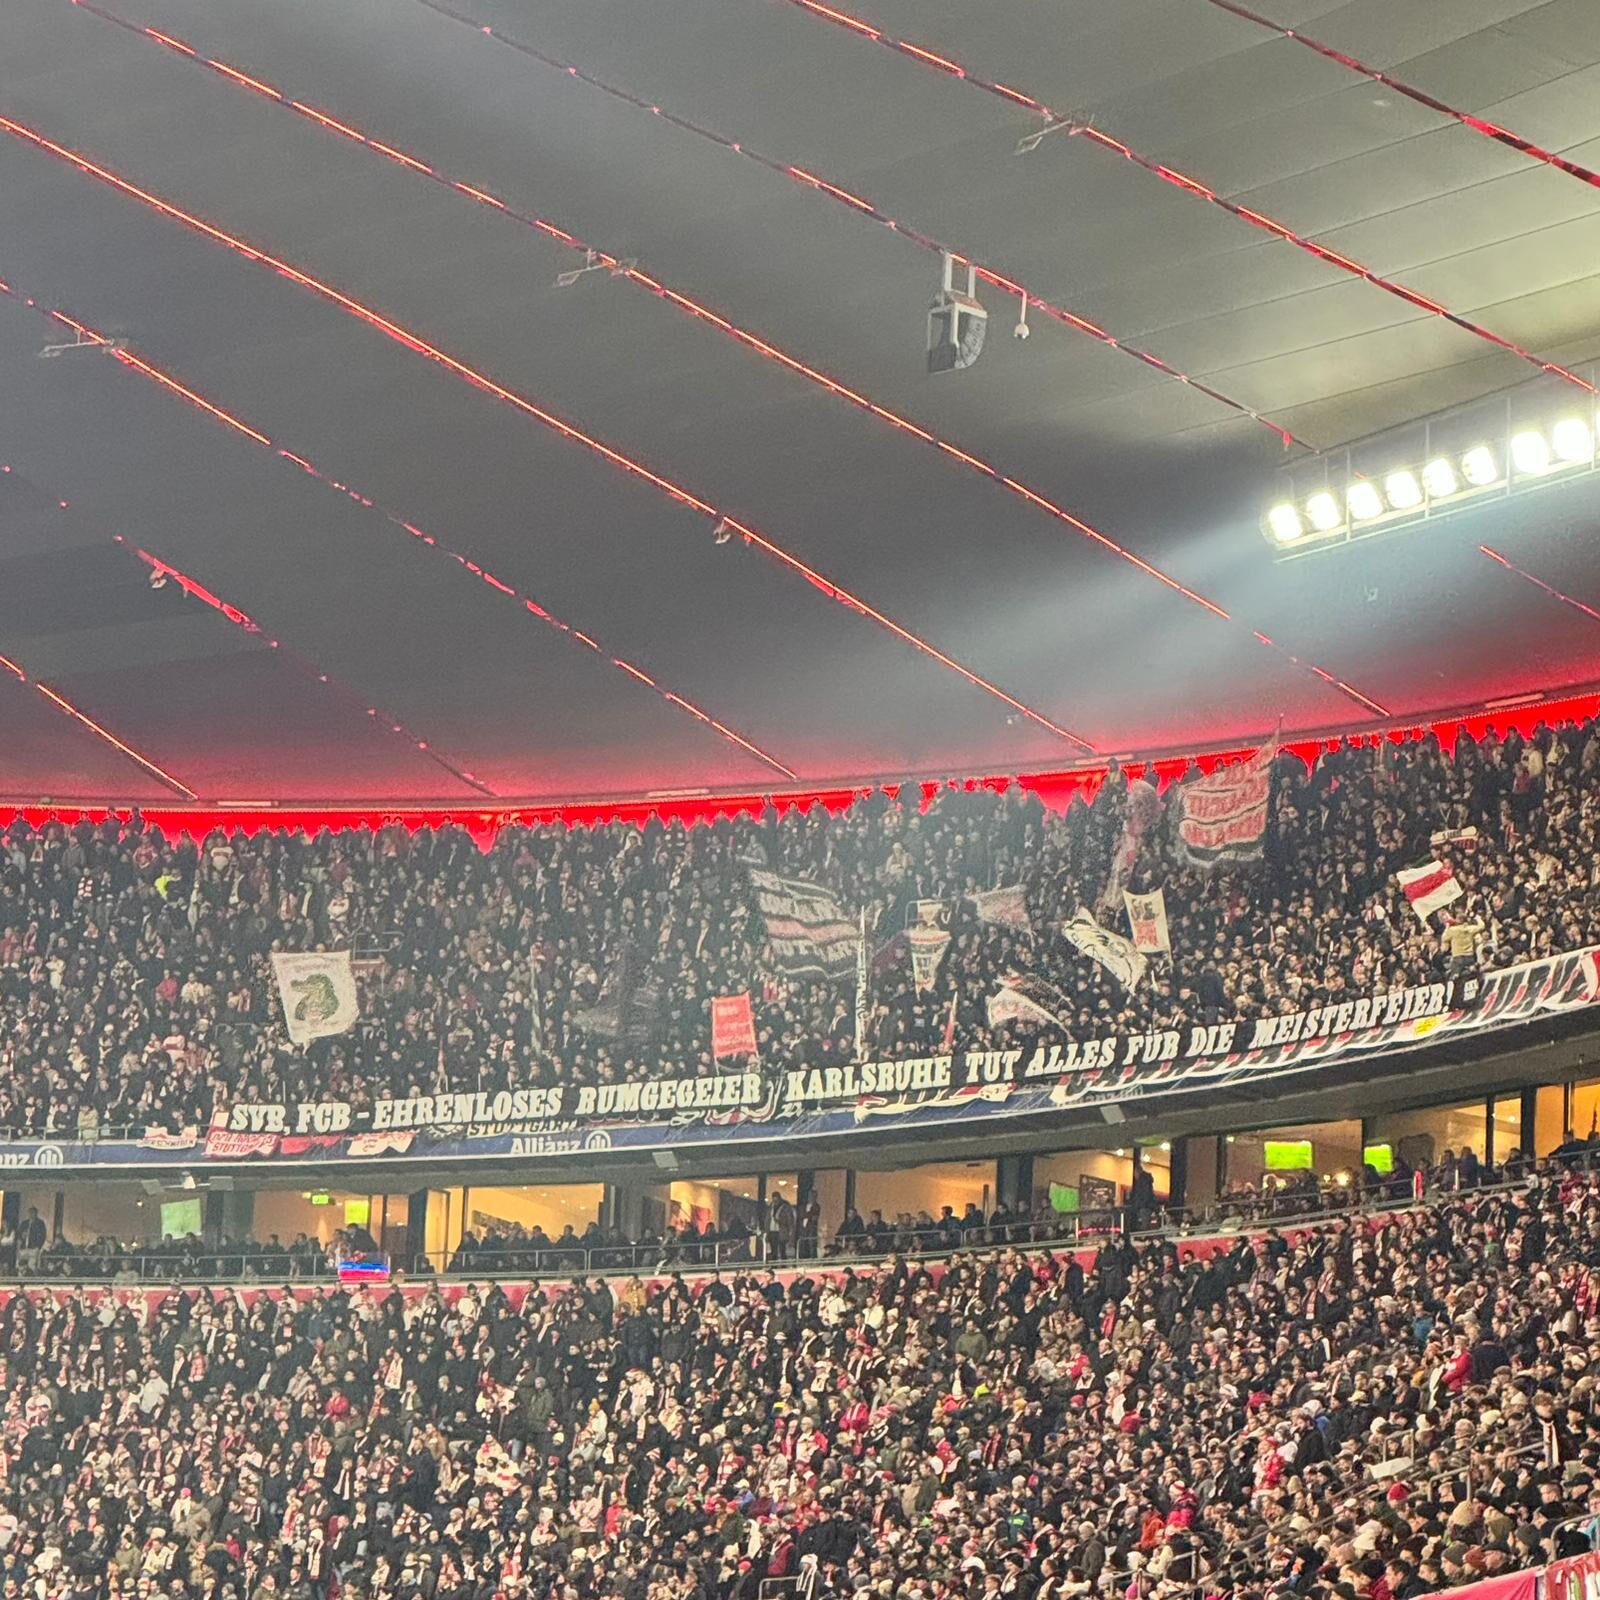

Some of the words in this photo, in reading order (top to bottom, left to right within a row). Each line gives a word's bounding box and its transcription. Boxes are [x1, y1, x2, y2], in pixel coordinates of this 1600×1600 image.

[296, 1102, 351, 1133] FCB
[372, 1087, 564, 1129] EHRENLOSES
[574, 1072, 762, 1115] RUMGEGEIER
[784, 1056, 952, 1102] KARLSRUHE
[965, 1050, 1023, 1083] TUT
[1024, 1036, 1117, 1077] ALLES
[1122, 1028, 1181, 1066] FÜR
[1185, 1023, 1237, 1057] DIE
[1249, 981, 1454, 1050] MEISTERFEIER!
[511, 1136, 580, 1154] Allianz
